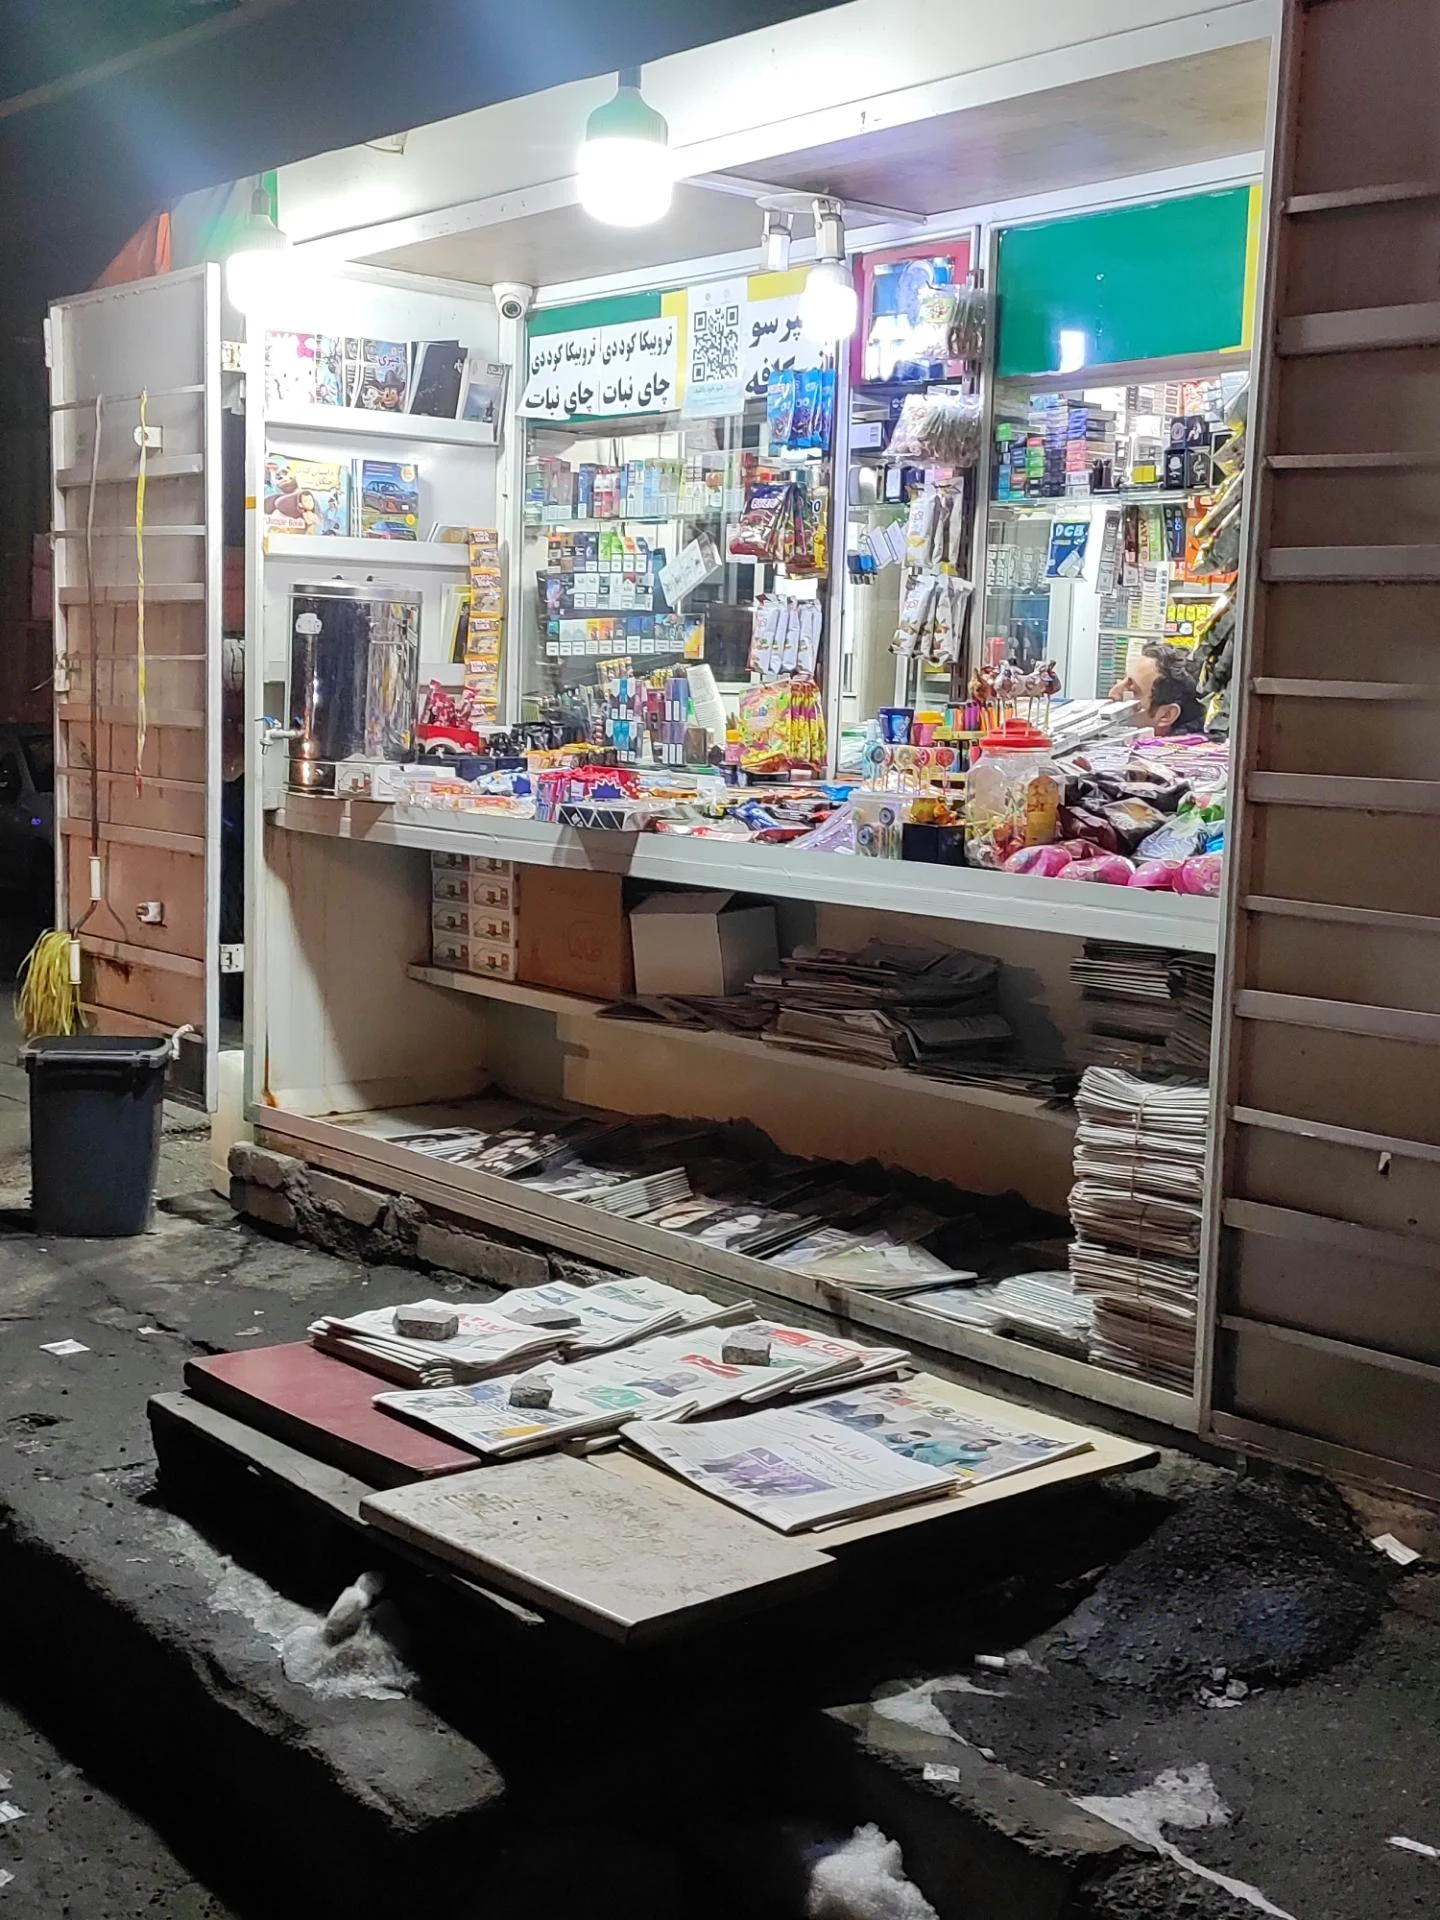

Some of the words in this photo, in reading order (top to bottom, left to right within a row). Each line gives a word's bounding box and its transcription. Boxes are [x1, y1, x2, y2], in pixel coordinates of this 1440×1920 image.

[525, 386, 560, 415] نبات
[564, 381, 594, 414] چای
[603, 376, 633, 408] نبات
[638, 372, 670, 407] چای
